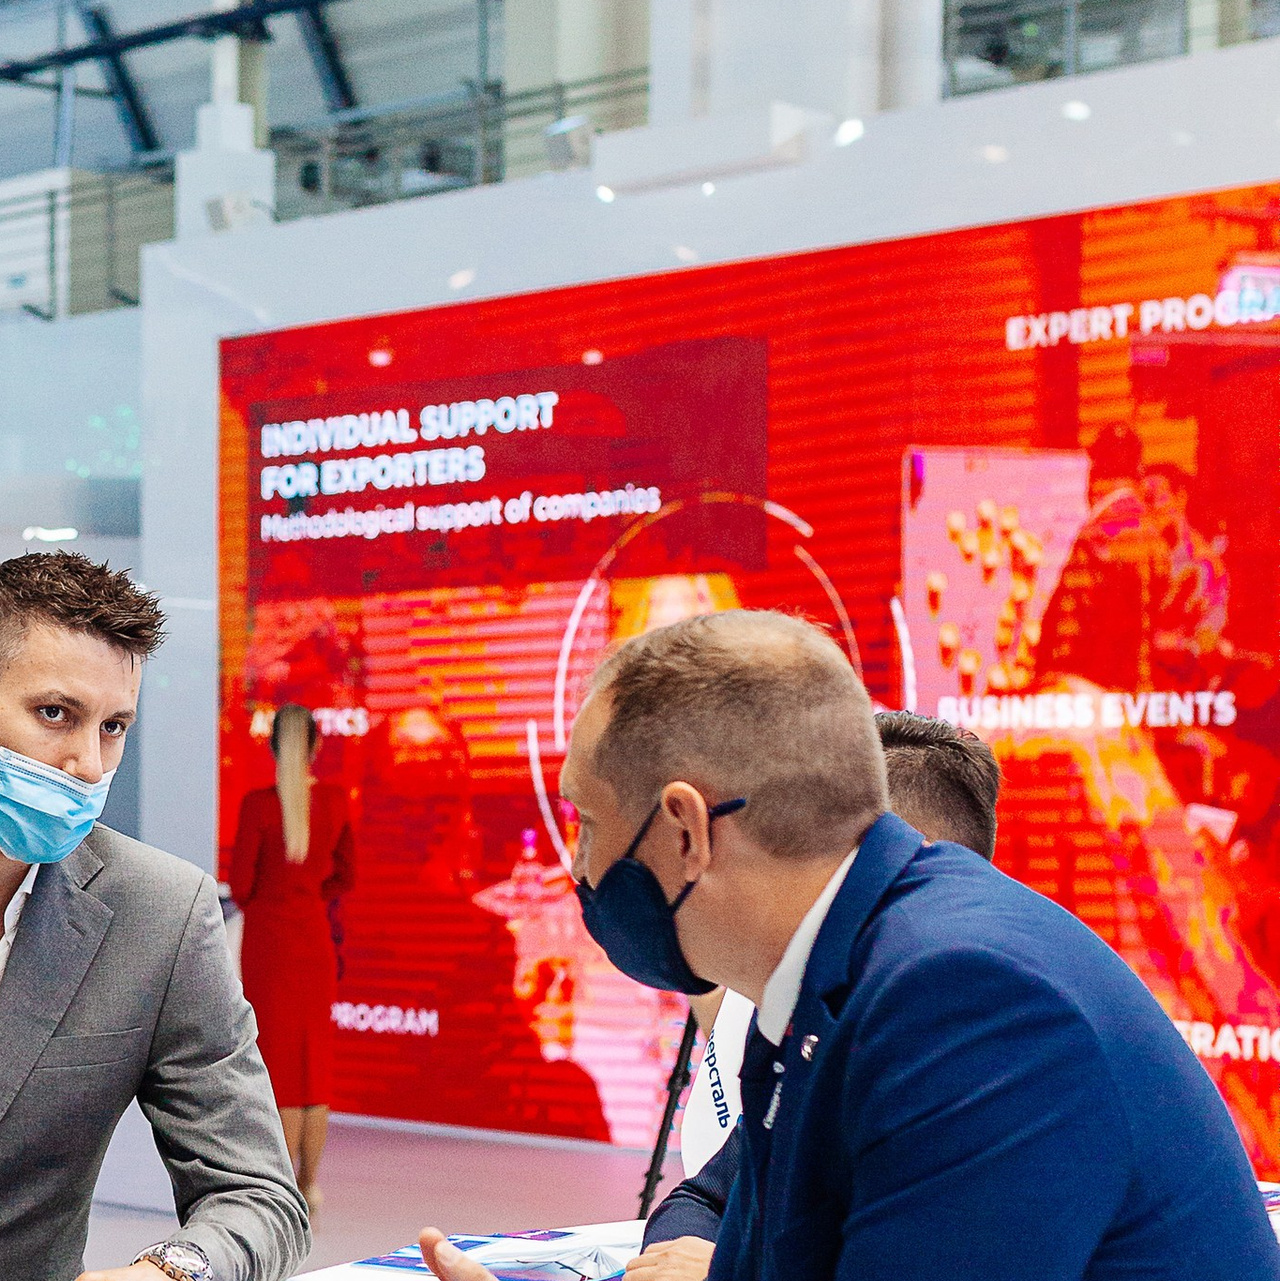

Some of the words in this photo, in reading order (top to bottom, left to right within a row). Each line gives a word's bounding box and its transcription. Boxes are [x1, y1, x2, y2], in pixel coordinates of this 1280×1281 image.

[1005, 302, 1134, 351] EXPERT
[260, 408, 418, 458] INDIVIDUAL
[419, 390, 559, 441] SUPPORT
[260, 461, 319, 500] FOR
[319, 445, 486, 496] EXPORTERS
[415, 496, 503, 533] support
[504, 490, 532, 524] of
[532, 483, 661, 524] companies
[937, 693, 1096, 730] BUSINESS
[1101, 690, 1238, 728] EVENTS
